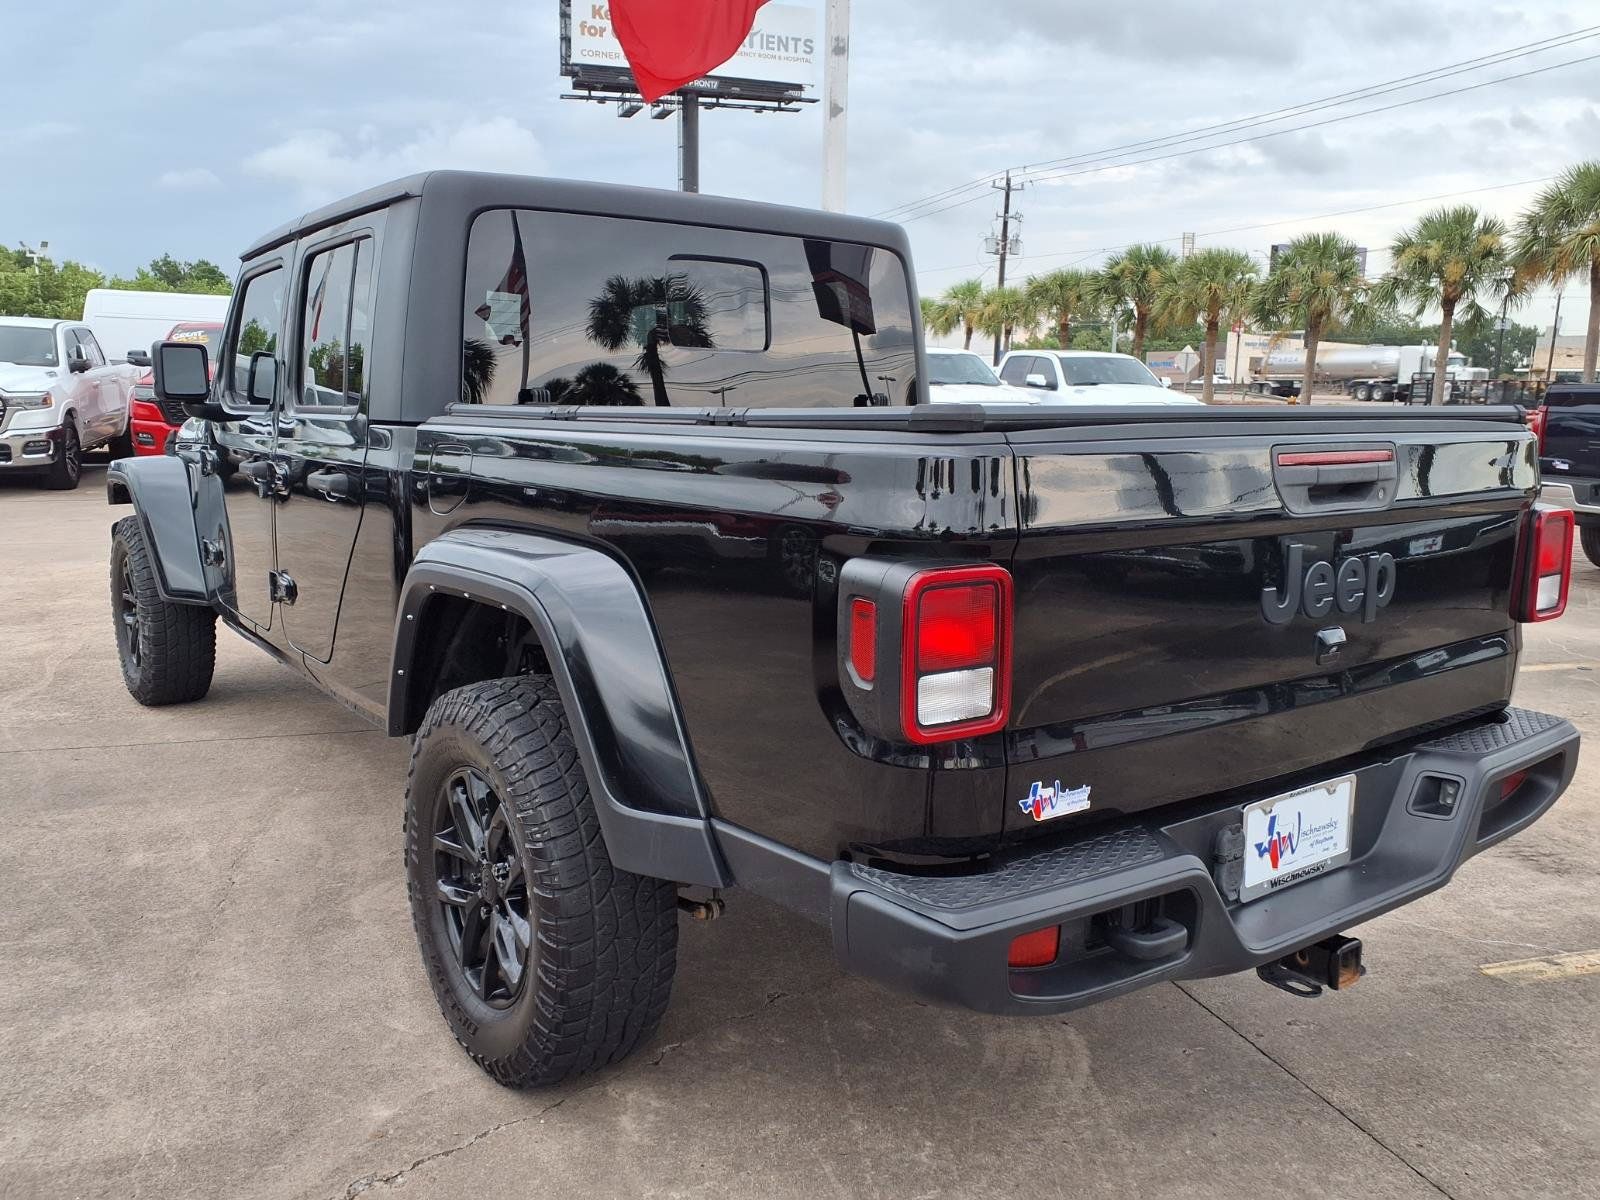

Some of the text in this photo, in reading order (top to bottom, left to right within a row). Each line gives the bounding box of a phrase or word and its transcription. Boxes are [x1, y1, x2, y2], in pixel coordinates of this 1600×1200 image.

[579, 21, 607, 38] for
[743, 28, 815, 55] TIENTS
[580, 48, 621, 60] CORNER
[1261, 544, 1397, 624] Jeep
[1270, 862, 1327, 889] Wischnewsky
